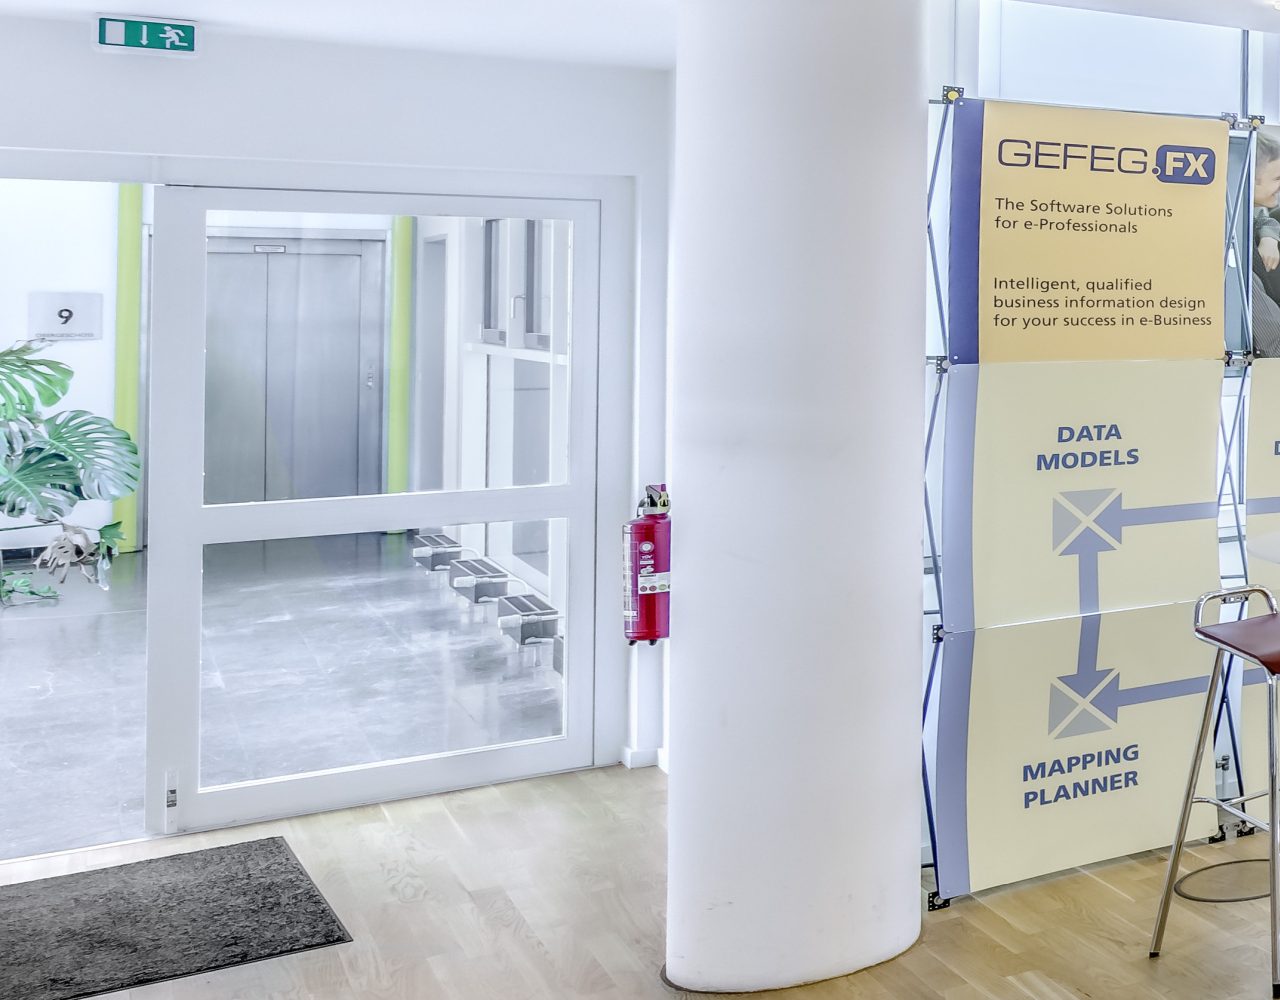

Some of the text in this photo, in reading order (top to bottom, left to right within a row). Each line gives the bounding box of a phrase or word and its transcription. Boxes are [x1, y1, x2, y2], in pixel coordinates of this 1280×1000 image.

[995, 197, 1173, 217] The Software Solutions
[995, 216, 1138, 233] for e-Professionals
[994, 277, 1152, 293] Intelligent, qualified
[994, 295, 1206, 311] business information design
[57, 308, 74, 325] 9
[993, 314, 1213, 329] for your success in e-Business
[1057, 423, 1122, 443] DATA
[1036, 448, 1139, 471] MODELS
[1022, 743, 1139, 782] MAPPING
[1024, 770, 1139, 809] PLANNER
